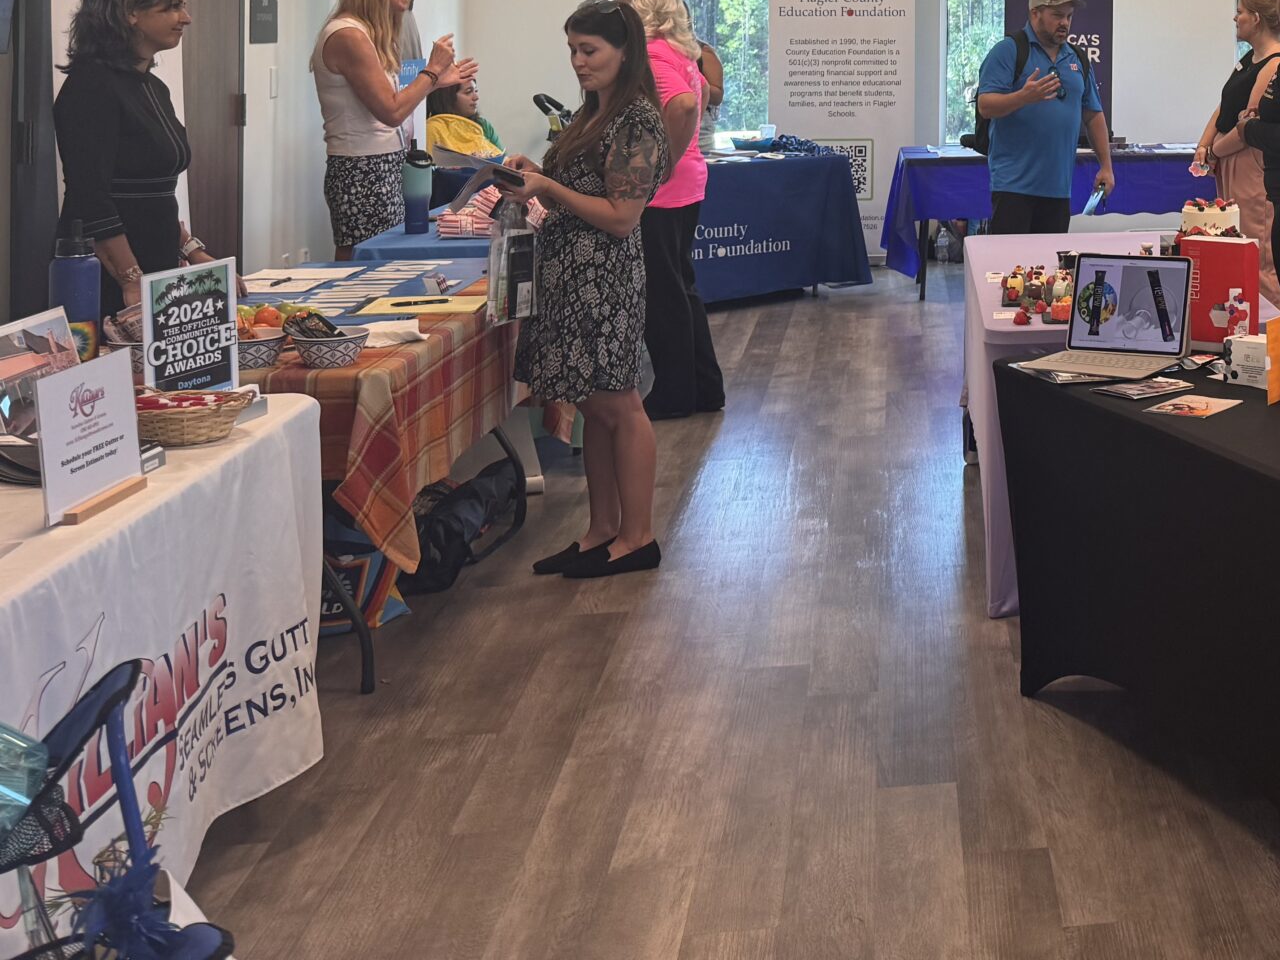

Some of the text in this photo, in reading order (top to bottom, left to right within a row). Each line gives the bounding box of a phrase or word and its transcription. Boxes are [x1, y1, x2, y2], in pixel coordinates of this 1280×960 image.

[778, 6, 906, 17] Education Foundation
[873, 38, 896, 47] Flagler
[788, 59, 820, 67] 501(c)(3)
[821, 59, 852, 67] nonprofit
[788, 70, 825, 78] generating
[856, 70, 882, 78] support
[790, 91, 823, 99] programs
[873, 101, 897, 109] Flagler
[693, 223, 749, 241] County
[707, 238, 791, 260] Foundation
[168, 298, 214, 326] 2024
[163, 316, 221, 337] THE OFFICIAL
[165, 324, 221, 345] COMMUNITY'S
[147, 320, 237, 367] CHOICE
[164, 350, 222, 377] AWARDS
[178, 374, 212, 391] Daytona
[188, 770, 198, 802] &
